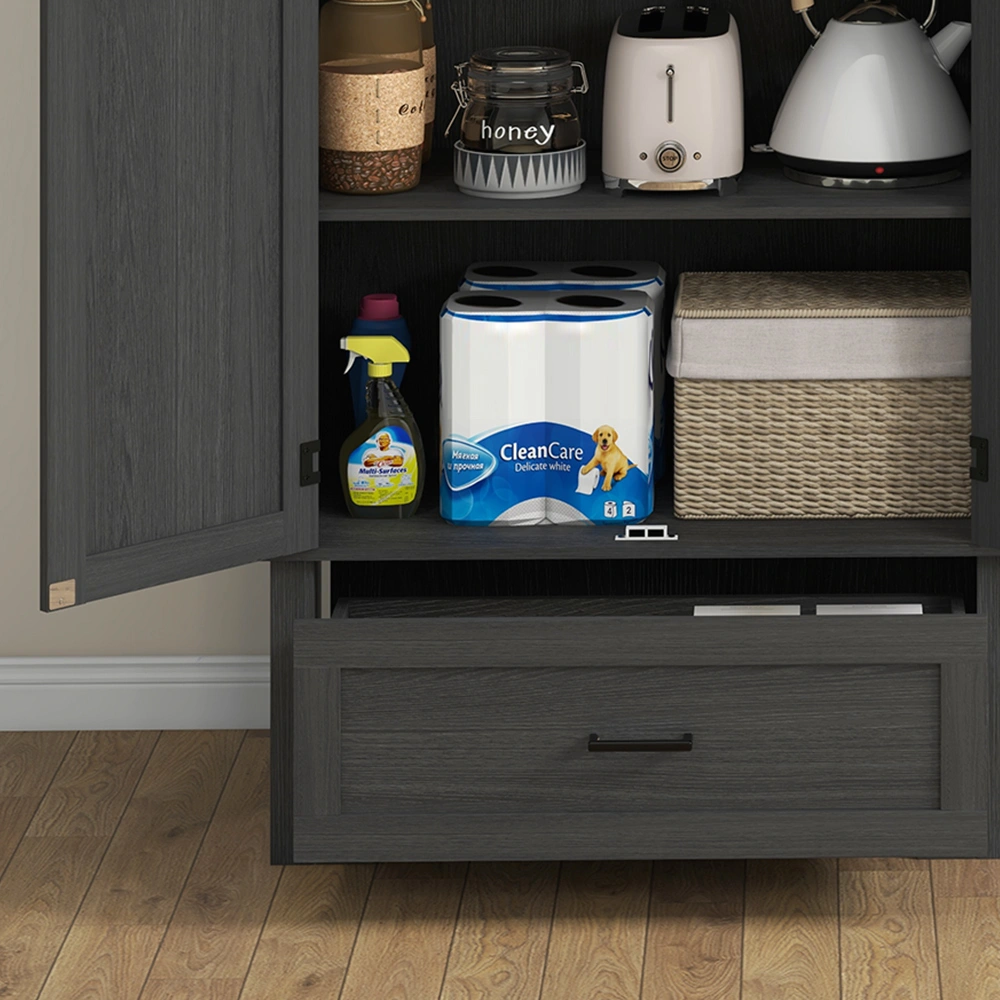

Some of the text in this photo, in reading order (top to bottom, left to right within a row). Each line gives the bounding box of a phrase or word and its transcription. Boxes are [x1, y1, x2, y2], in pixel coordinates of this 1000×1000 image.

[480, 120, 556, 145] honey
[500, 442, 584, 461] CleanCare
[515, 461, 571, 472] Delicate white
[626, 506, 632, 514] 2
